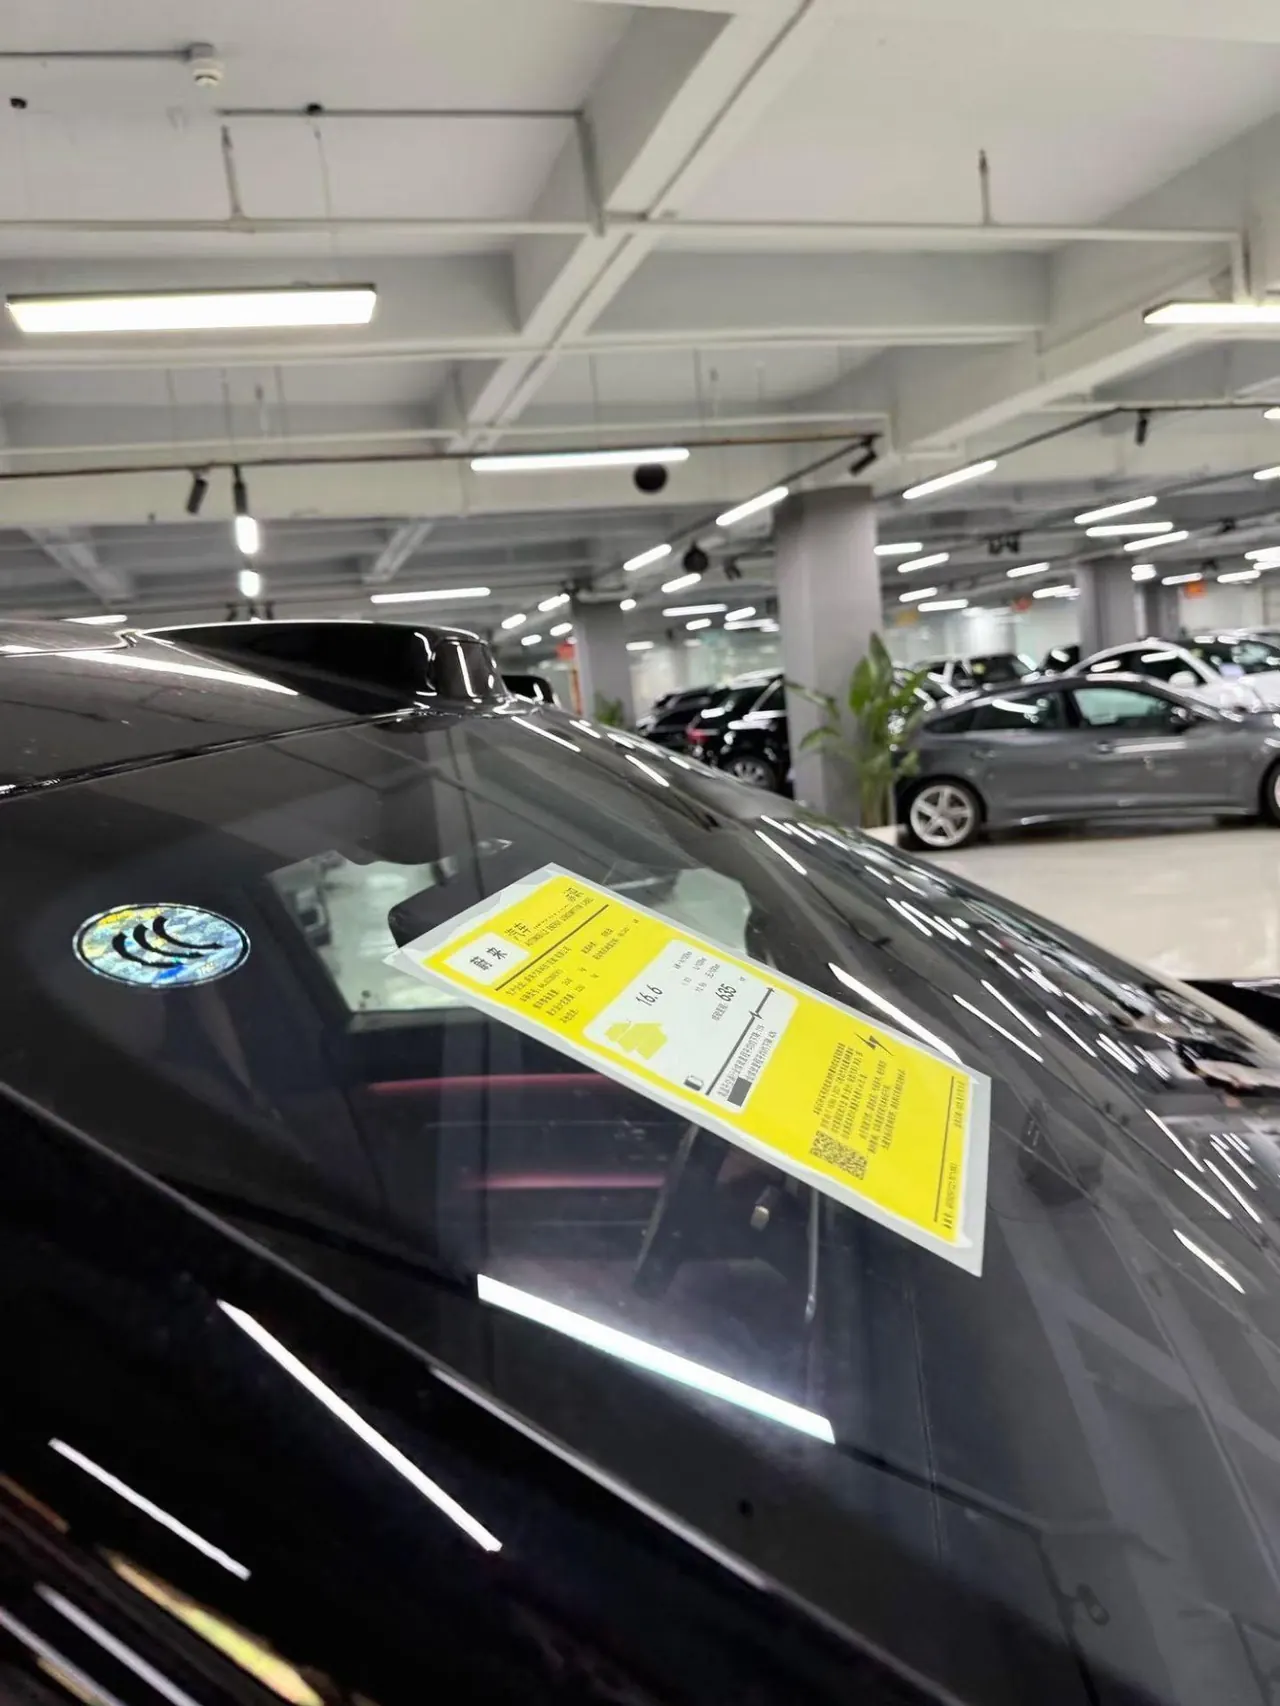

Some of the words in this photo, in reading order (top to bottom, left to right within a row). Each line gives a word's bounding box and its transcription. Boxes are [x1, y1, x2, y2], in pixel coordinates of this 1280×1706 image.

[468, 945, 510, 972] 蔚来
[634, 983, 664, 1007] 16.6
[714, 983, 737, 1002] 635
